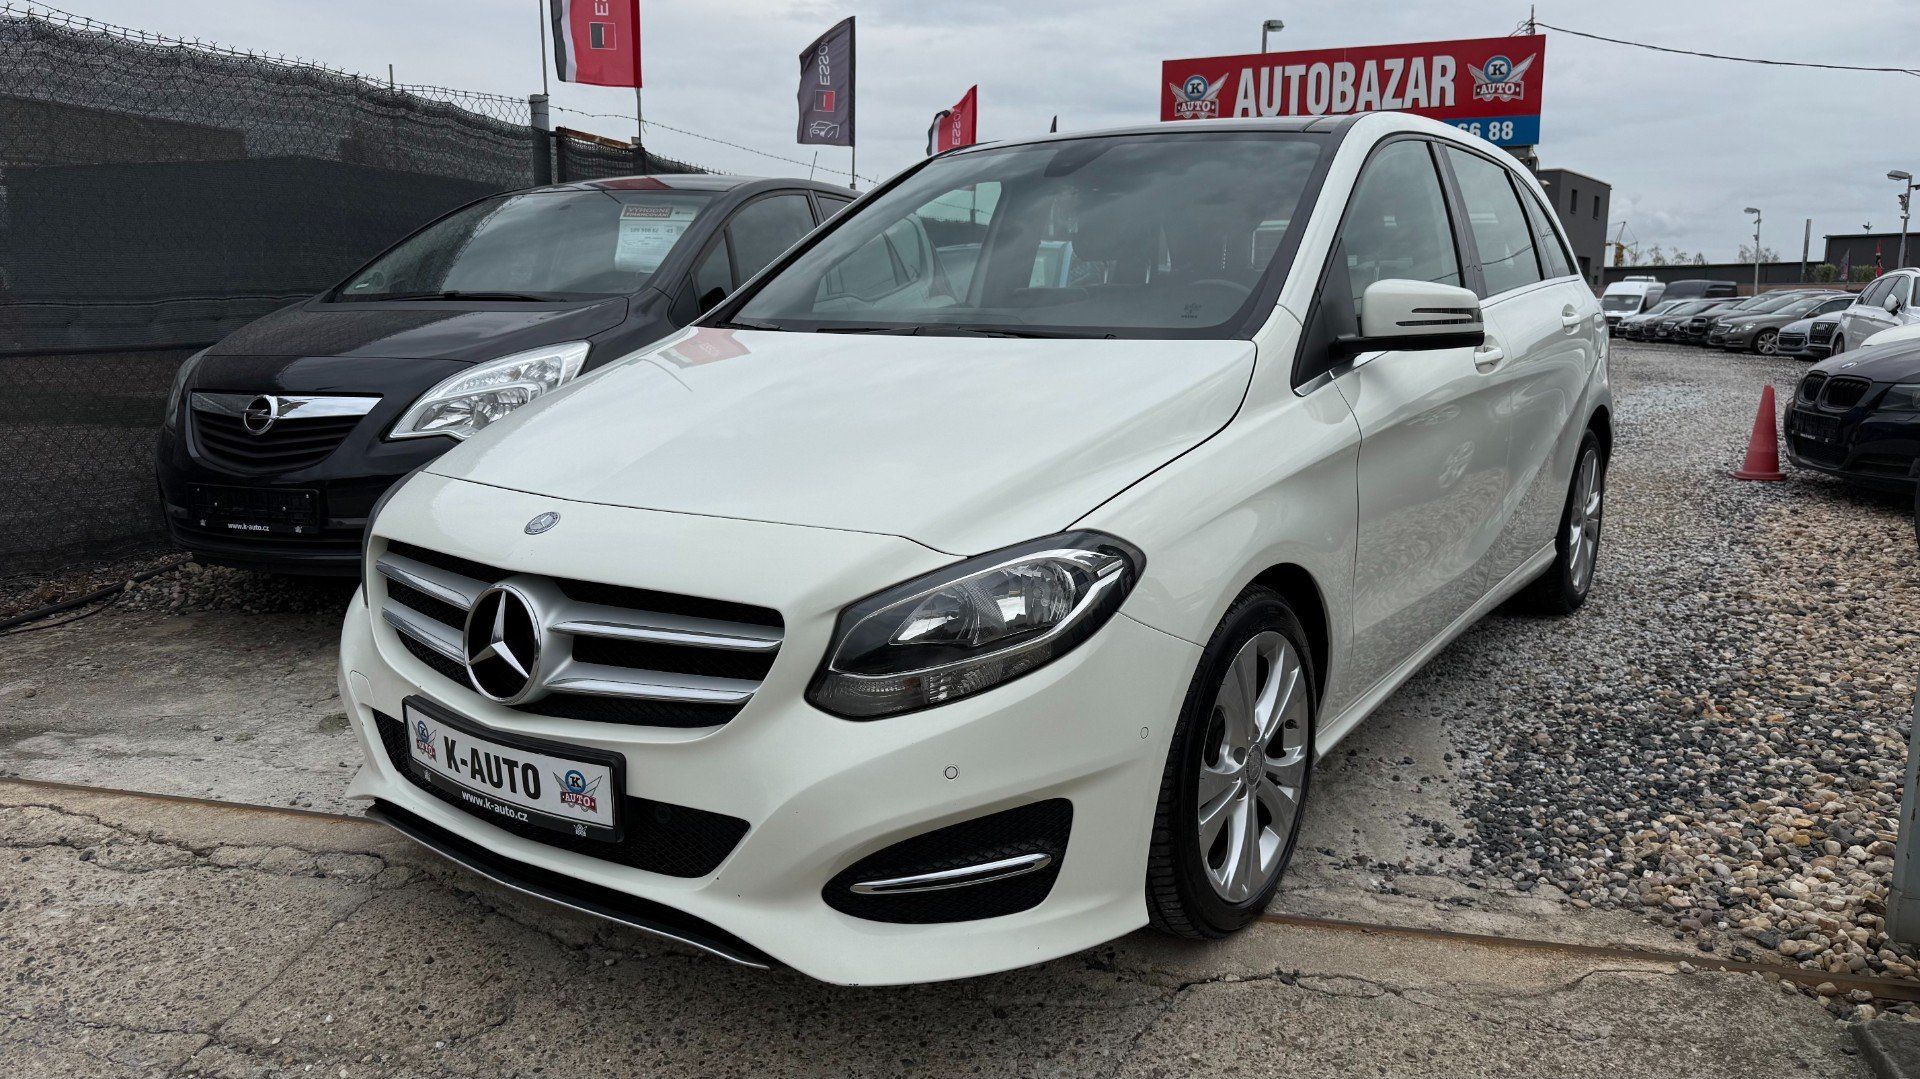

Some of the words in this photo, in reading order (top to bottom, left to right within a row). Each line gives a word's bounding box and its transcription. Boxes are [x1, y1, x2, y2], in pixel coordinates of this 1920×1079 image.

[1491, 64, 1505, 75] K
[1190, 83, 1202, 94] K
[1233, 54, 1457, 118] AUTOBAZAR
[1481, 83, 1515, 94] AUTO
[1181, 101, 1211, 112] AUTO
[1488, 121, 1514, 141] 88
[443, 735, 541, 800] K-AUTO
[570, 775, 582, 788] K
[461, 790, 529, 822] www.k-auto.cz
[565, 793, 590, 807] AUTO
